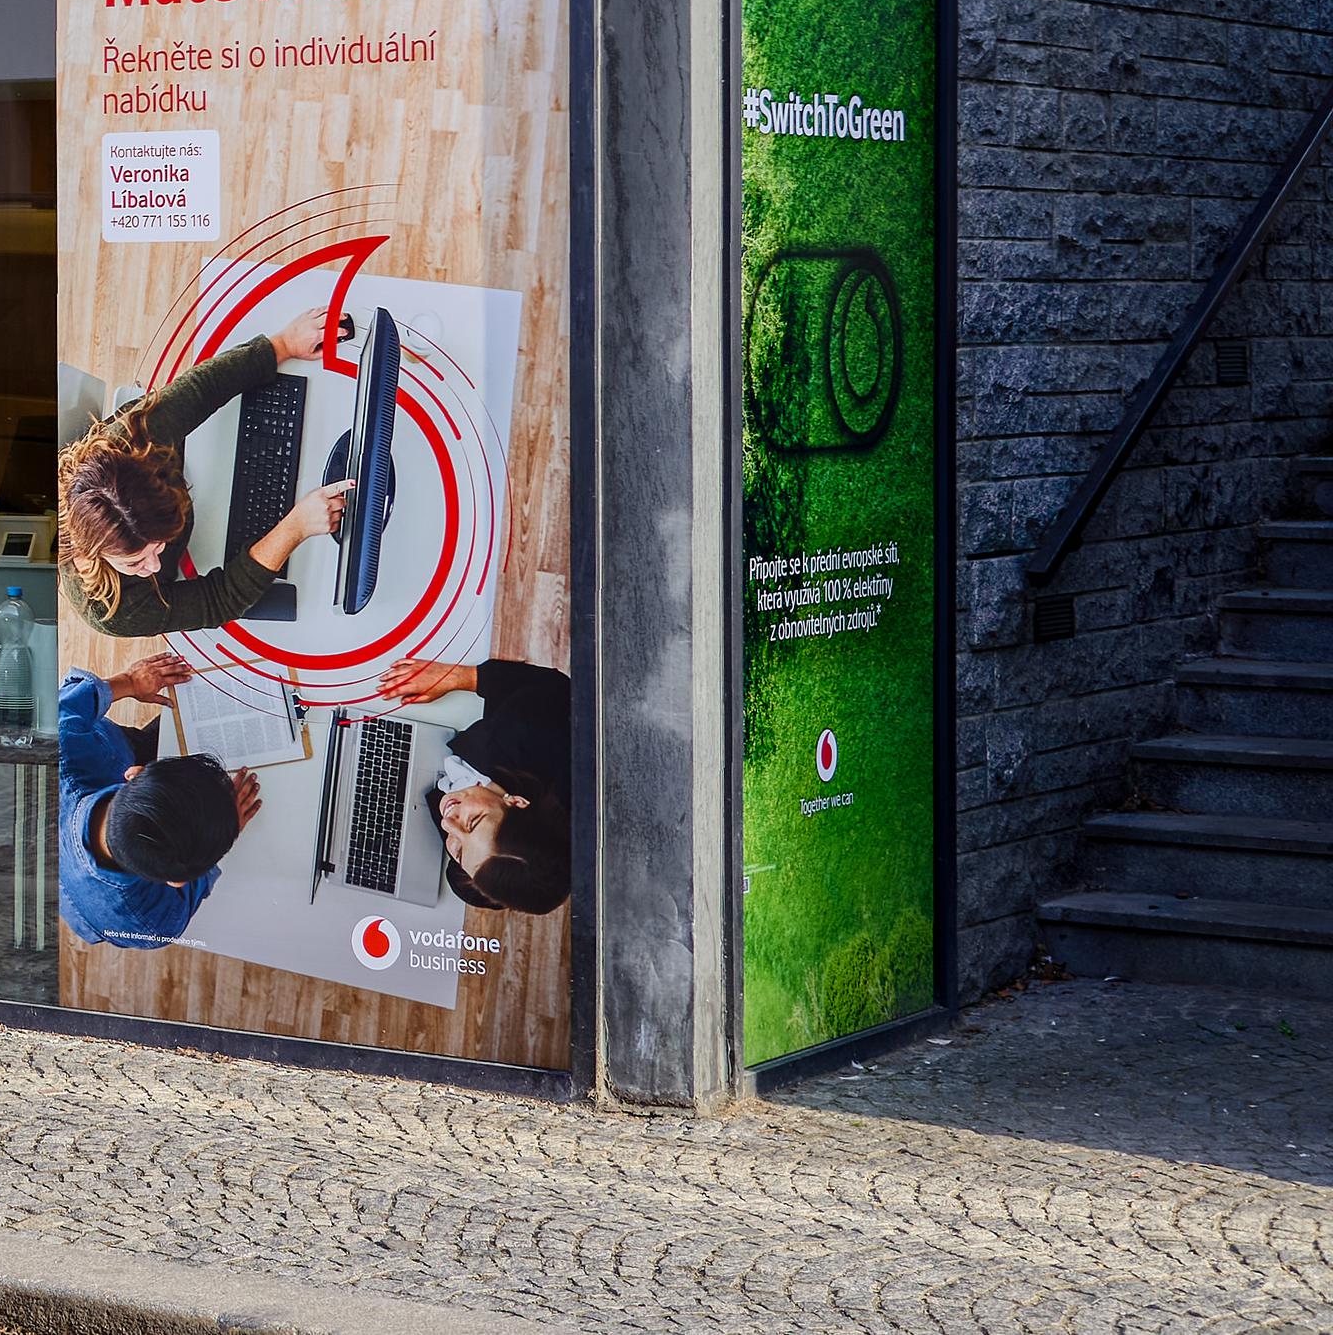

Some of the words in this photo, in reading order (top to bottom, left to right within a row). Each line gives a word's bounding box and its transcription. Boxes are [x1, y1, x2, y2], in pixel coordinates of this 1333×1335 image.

[103, 37, 212, 74] Řekněte
[221, 39, 241, 70] si
[249, 45, 266, 68] o
[274, 30, 437, 68] individuální
[102, 83, 208, 115] nabídku
[743, 87, 906, 143] #SwitchToGreen
[110, 144, 177, 160] Kontaktujte
[179, 142, 203, 158] nás:
[110, 164, 190, 184] Veronika
[111, 187, 187, 209] Líbalová
[110, 214, 140, 229] +420
[142, 214, 163, 229] 771
[166, 214, 187, 229] 155
[190, 213, 210, 229] 116
[749, 555, 787, 584] Připojte
[789, 558, 801, 576] se
[802, 551, 809, 574] k
[810, 546, 841, 577] přední
[842, 542, 883, 572] evropské
[885, 541, 900, 565] síti,
[757, 585, 782, 612] která
[784, 581, 820, 612] využívá
[823, 578, 841, 602] 100
[842, 577, 852, 600] %
[853, 572, 893, 599] elektřiny
[770, 624, 776, 641] z
[778, 609, 846, 640] obnovitelných
[800, 795, 830, 817] Together
[831, 794, 841, 807] we
[842, 792, 854, 805] can
[119, 931, 130, 939] více
[409, 929, 501, 953] vodafone
[410, 949, 486, 975] business
